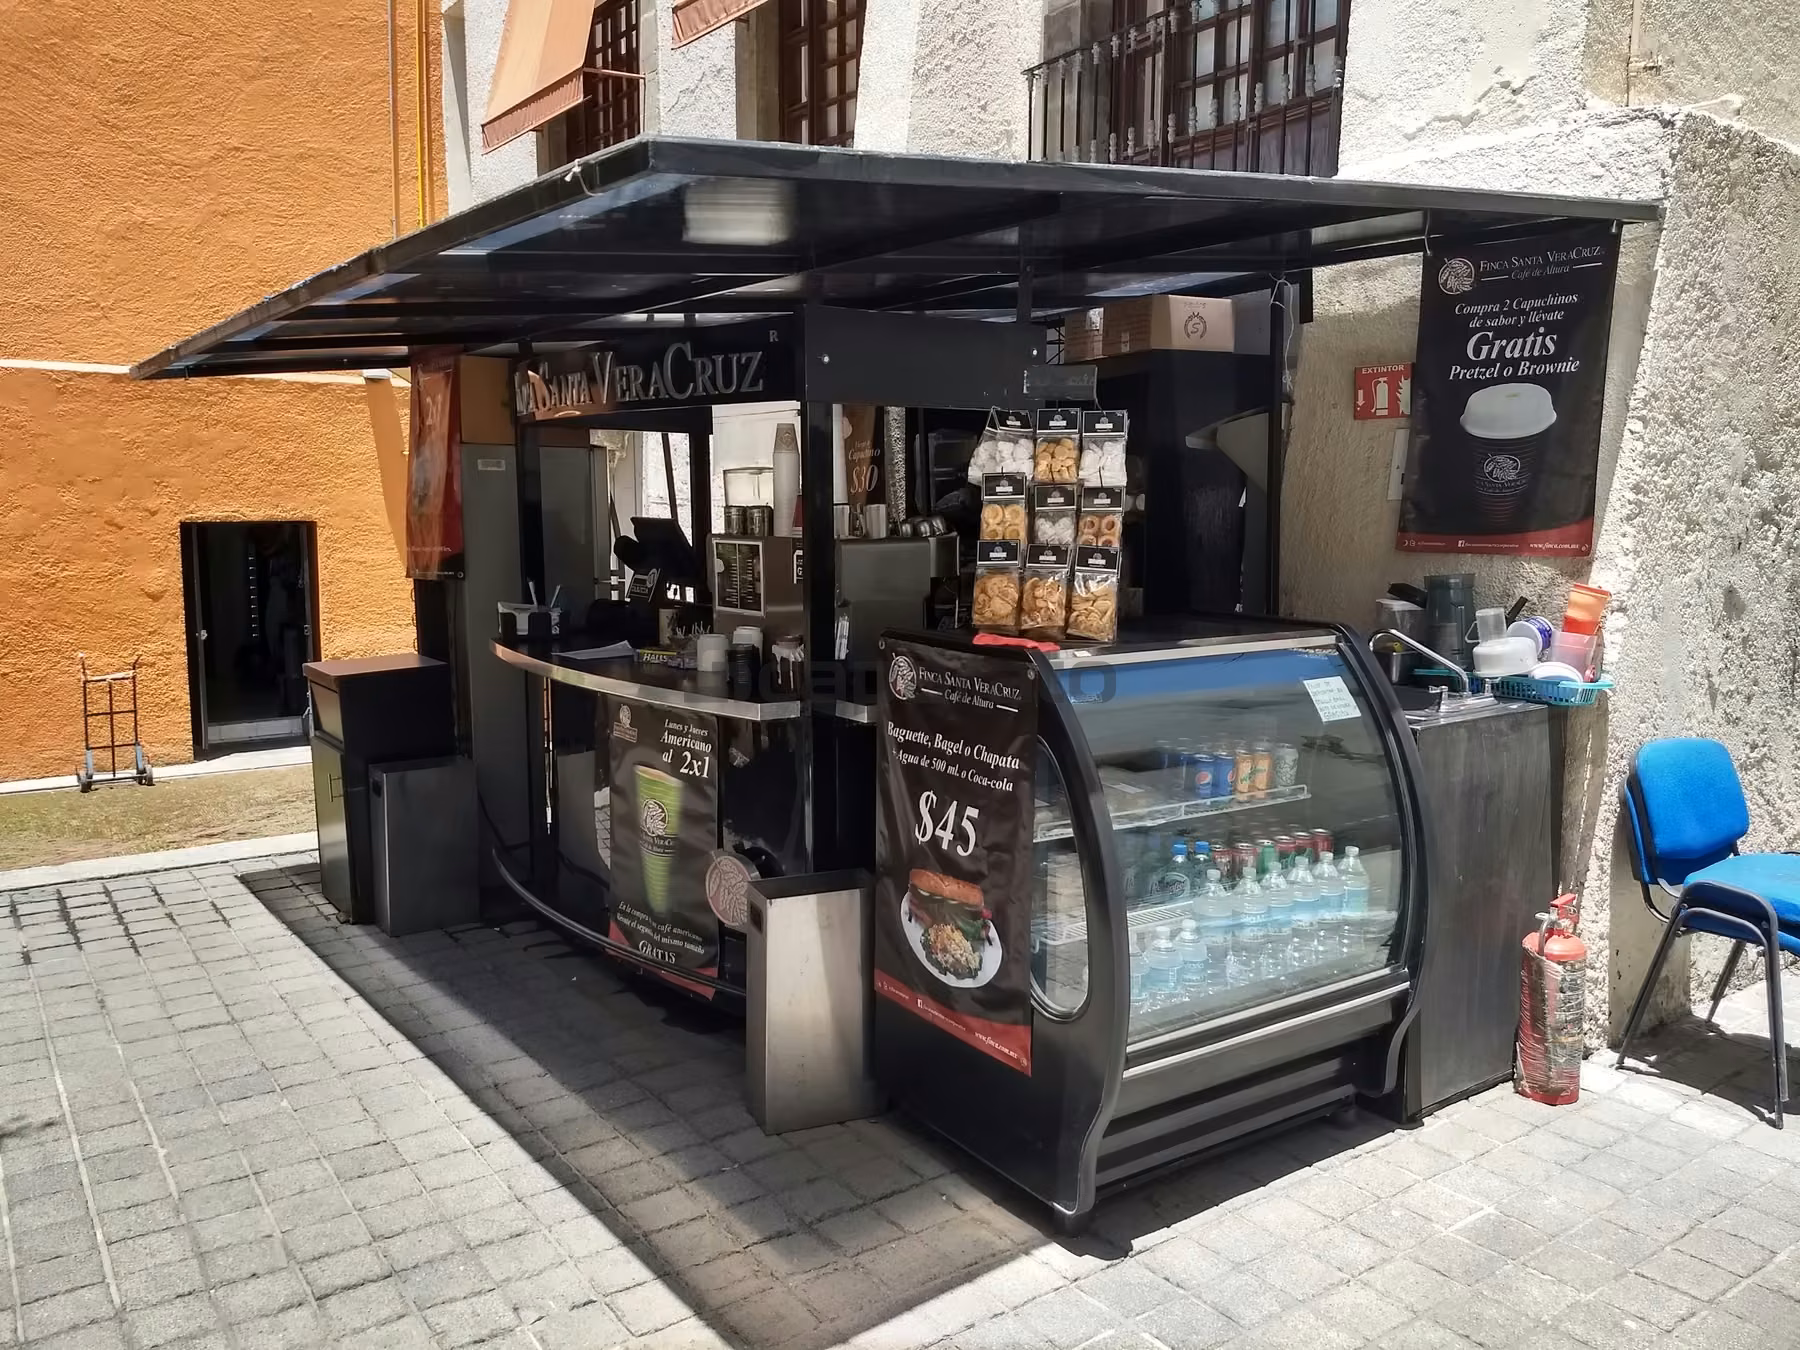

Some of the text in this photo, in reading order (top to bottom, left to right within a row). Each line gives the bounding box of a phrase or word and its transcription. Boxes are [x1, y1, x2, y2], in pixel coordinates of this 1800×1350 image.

[1480, 246, 1601, 272] FINCA SANTA VERACRUZ
[1511, 265, 1570, 280] Café de Altura
[1455, 292, 1579, 316] Compra 2 Capuchinos
[1469, 310, 1564, 328] de sabor y llévate
[1466, 327, 1557, 361] Gratis
[592, 341, 763, 404] VERACRUZ
[1362, 365, 1404, 374] EXTINTOR
[1449, 357, 1580, 380] Pretzel o Brownie
[643, 653, 668, 662] HALLS
[919, 667, 943, 684] FINCA
[944, 672, 971, 690] SANTA
[974, 677, 1020, 700] VERACRUZ
[944, 690, 994, 709] Café de Altura
[664, 718, 683, 731] Lunes
[683, 725, 689, 734] y
[660, 729, 712, 753] Americano
[887, 721, 1020, 769] Baguette, Bagel o Chapata
[662, 748, 709, 779] al 2x1
[896, 749, 919, 765] Agua
[920, 754, 930, 768] de
[931, 757, 947, 772] 500
[961, 770, 967, 779] o
[967, 768, 1014, 792] Coca-cola
[914, 789, 980, 857] $45
[657, 923, 672, 934] café
[661, 935, 684, 946] mismo
[638, 940, 677, 964] GRATIS
